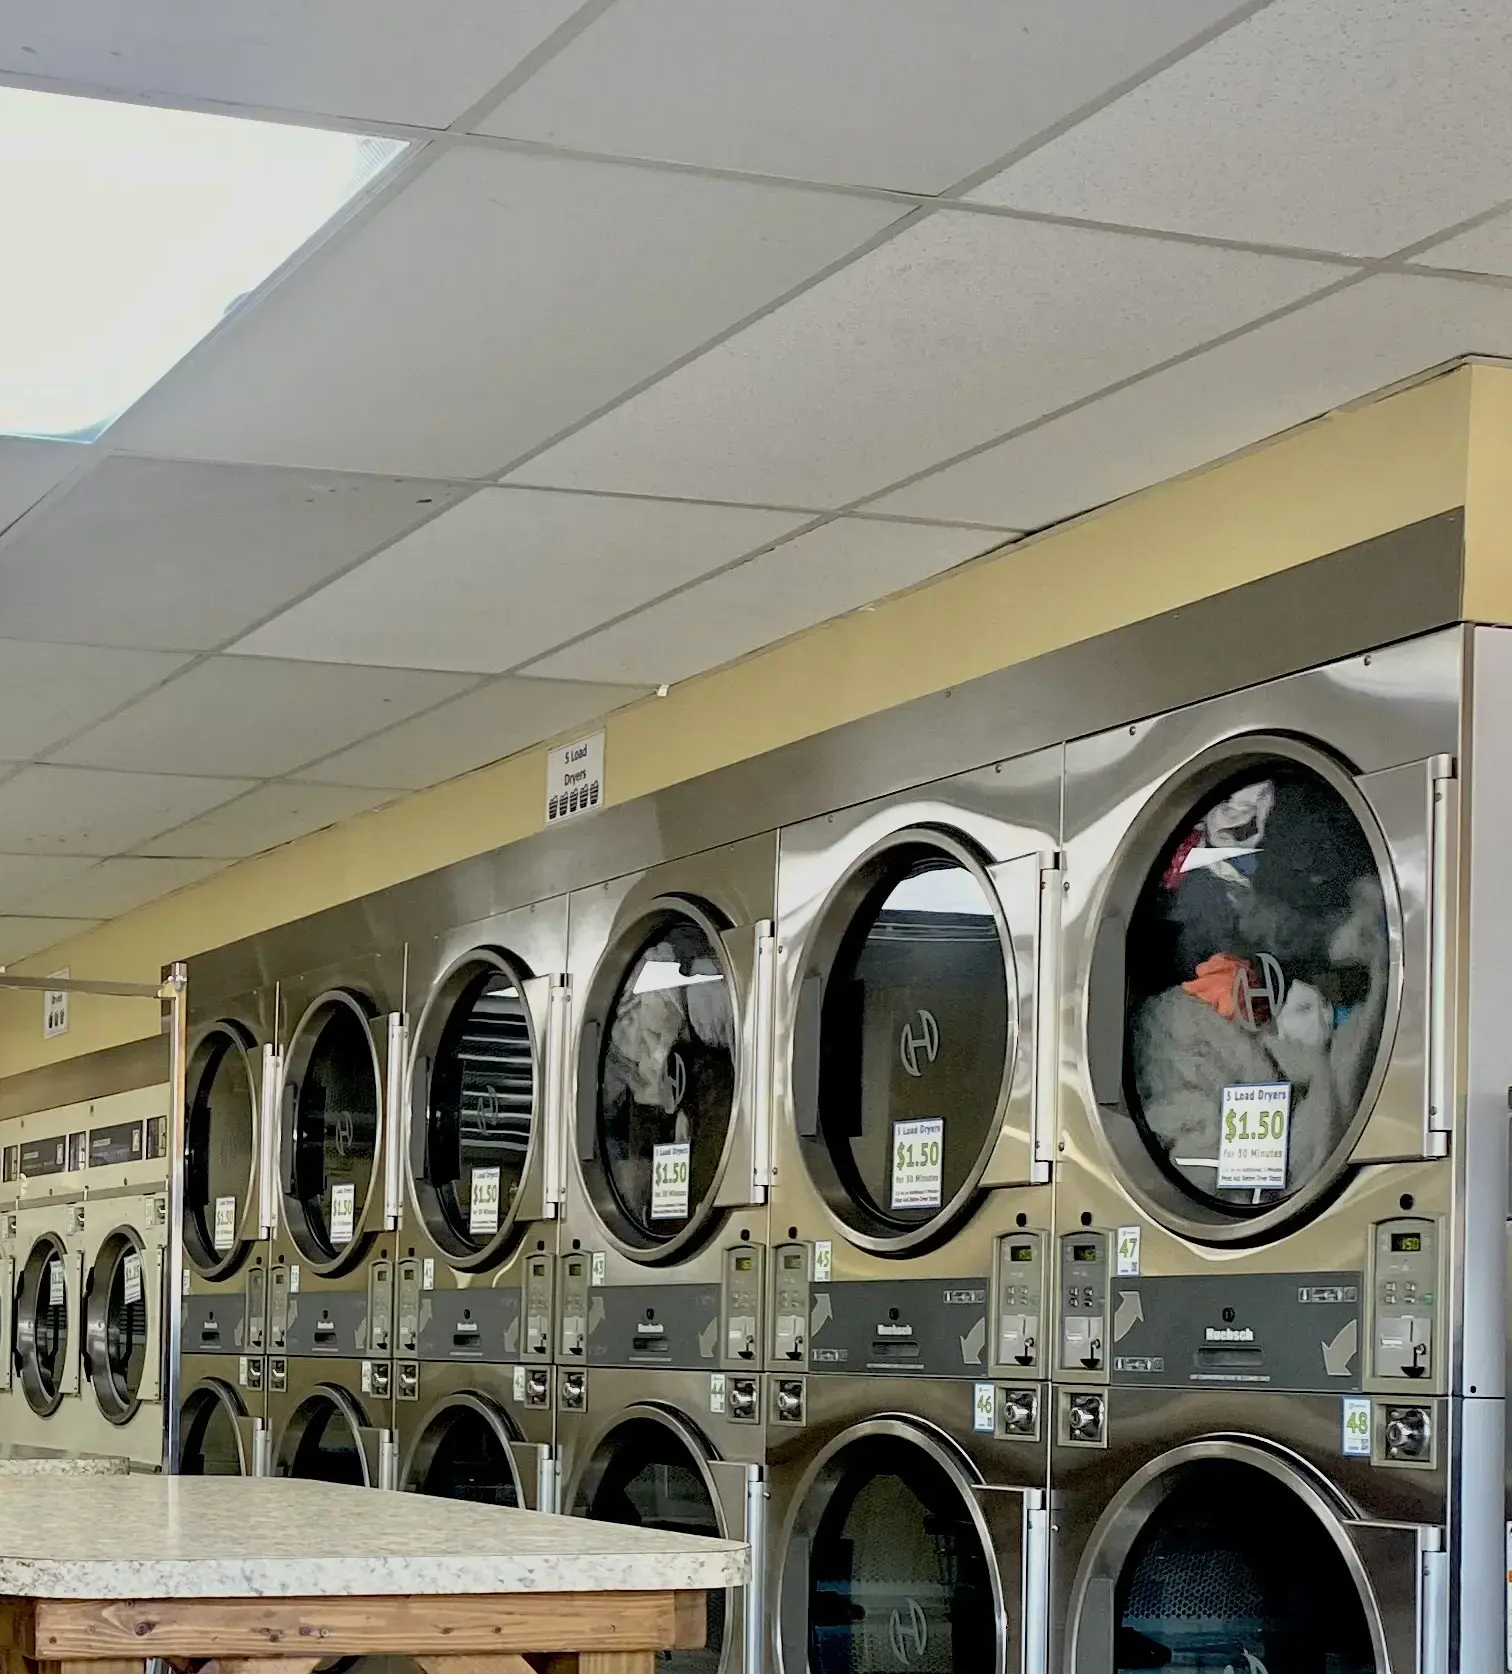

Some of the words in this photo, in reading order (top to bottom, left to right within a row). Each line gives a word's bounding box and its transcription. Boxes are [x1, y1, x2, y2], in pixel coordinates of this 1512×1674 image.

[570, 743, 588, 763] Load
[564, 768, 586, 787] Dryers
[1234, 1090, 1255, 1101] Load
[1257, 1089, 1287, 1102] Dryers
[1224, 1108, 1285, 1143] $1.50
[896, 1141, 940, 1171] $1.50
[655, 1161, 687, 1187] $1.50
[473, 1184, 497, 1206] $1.50
[1119, 1238, 1138, 1258] 47
[816, 1250, 830, 1268] 45
[976, 1394, 993, 1414] 46
[1346, 1411, 1369, 1435] 48
